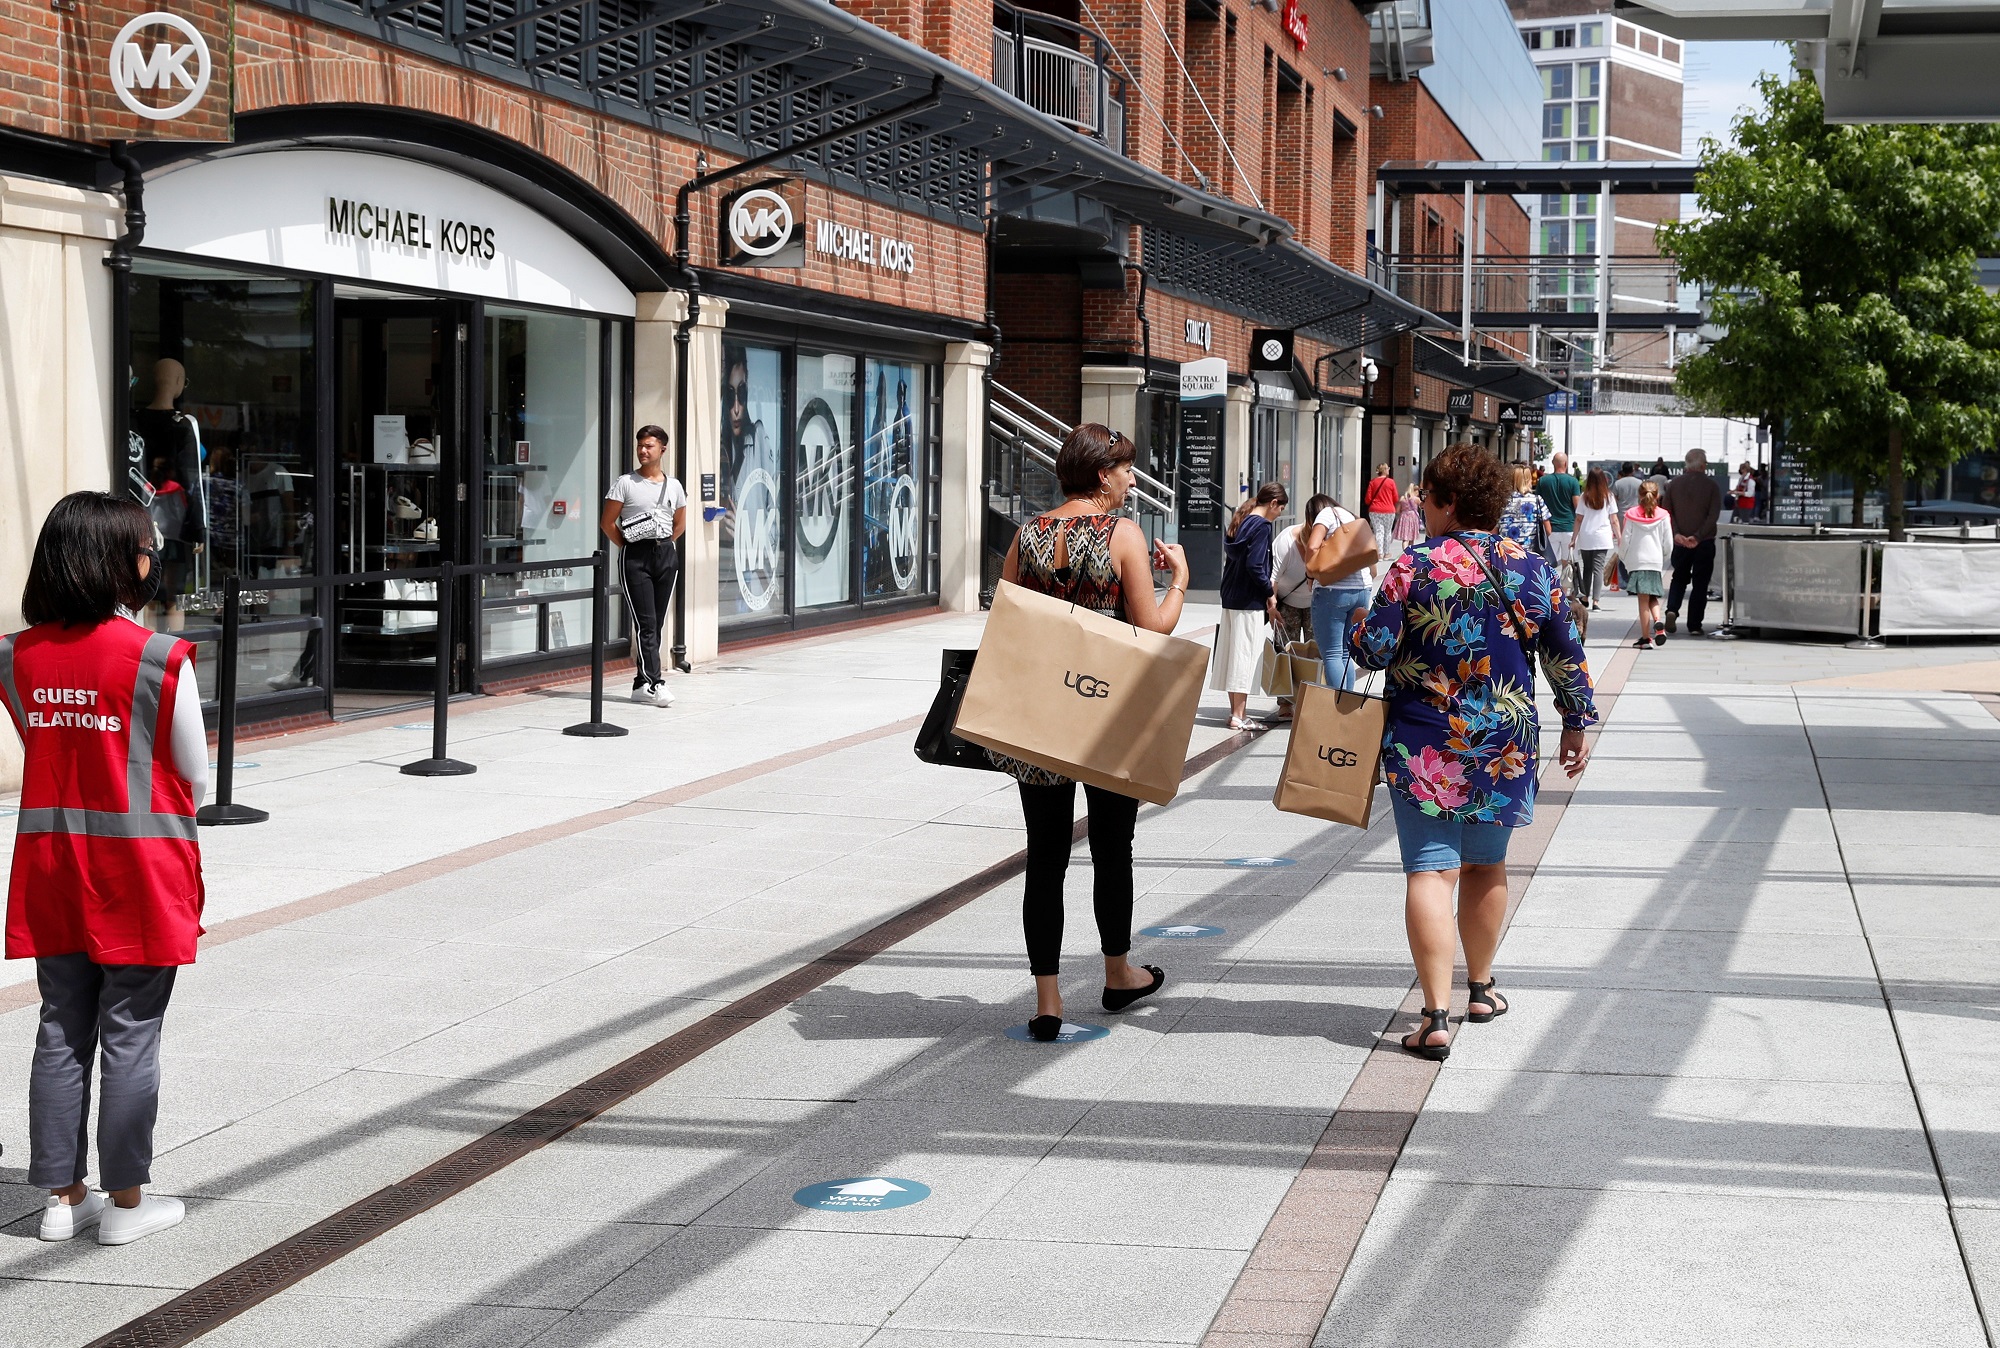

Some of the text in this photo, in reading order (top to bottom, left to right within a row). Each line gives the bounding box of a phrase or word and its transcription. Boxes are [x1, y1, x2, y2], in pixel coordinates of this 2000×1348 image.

[123, 42, 197, 90] MK
[329, 196, 496, 261] MICHAEL KORS
[738, 208, 784, 238] MK
[816, 219, 915, 275] MICHAEL KORS
[1186, 318, 1204, 346] STANCE
[1182, 375, 1220, 383] CENTRAL
[1182, 382, 1215, 391] SQUARE
[1196, 456, 1209, 464] Pho
[741, 508, 779, 572] MK
[893, 506, 918, 558] MK
[176, 590, 224, 612] MICHAE
[32, 687, 99, 706] GUEST
[1063, 670, 1111, 699] UGG
[26, 711, 122, 732] ELATIONS
[1317, 744, 1359, 768] UGG
[829, 1195, 885, 1203] WALK
